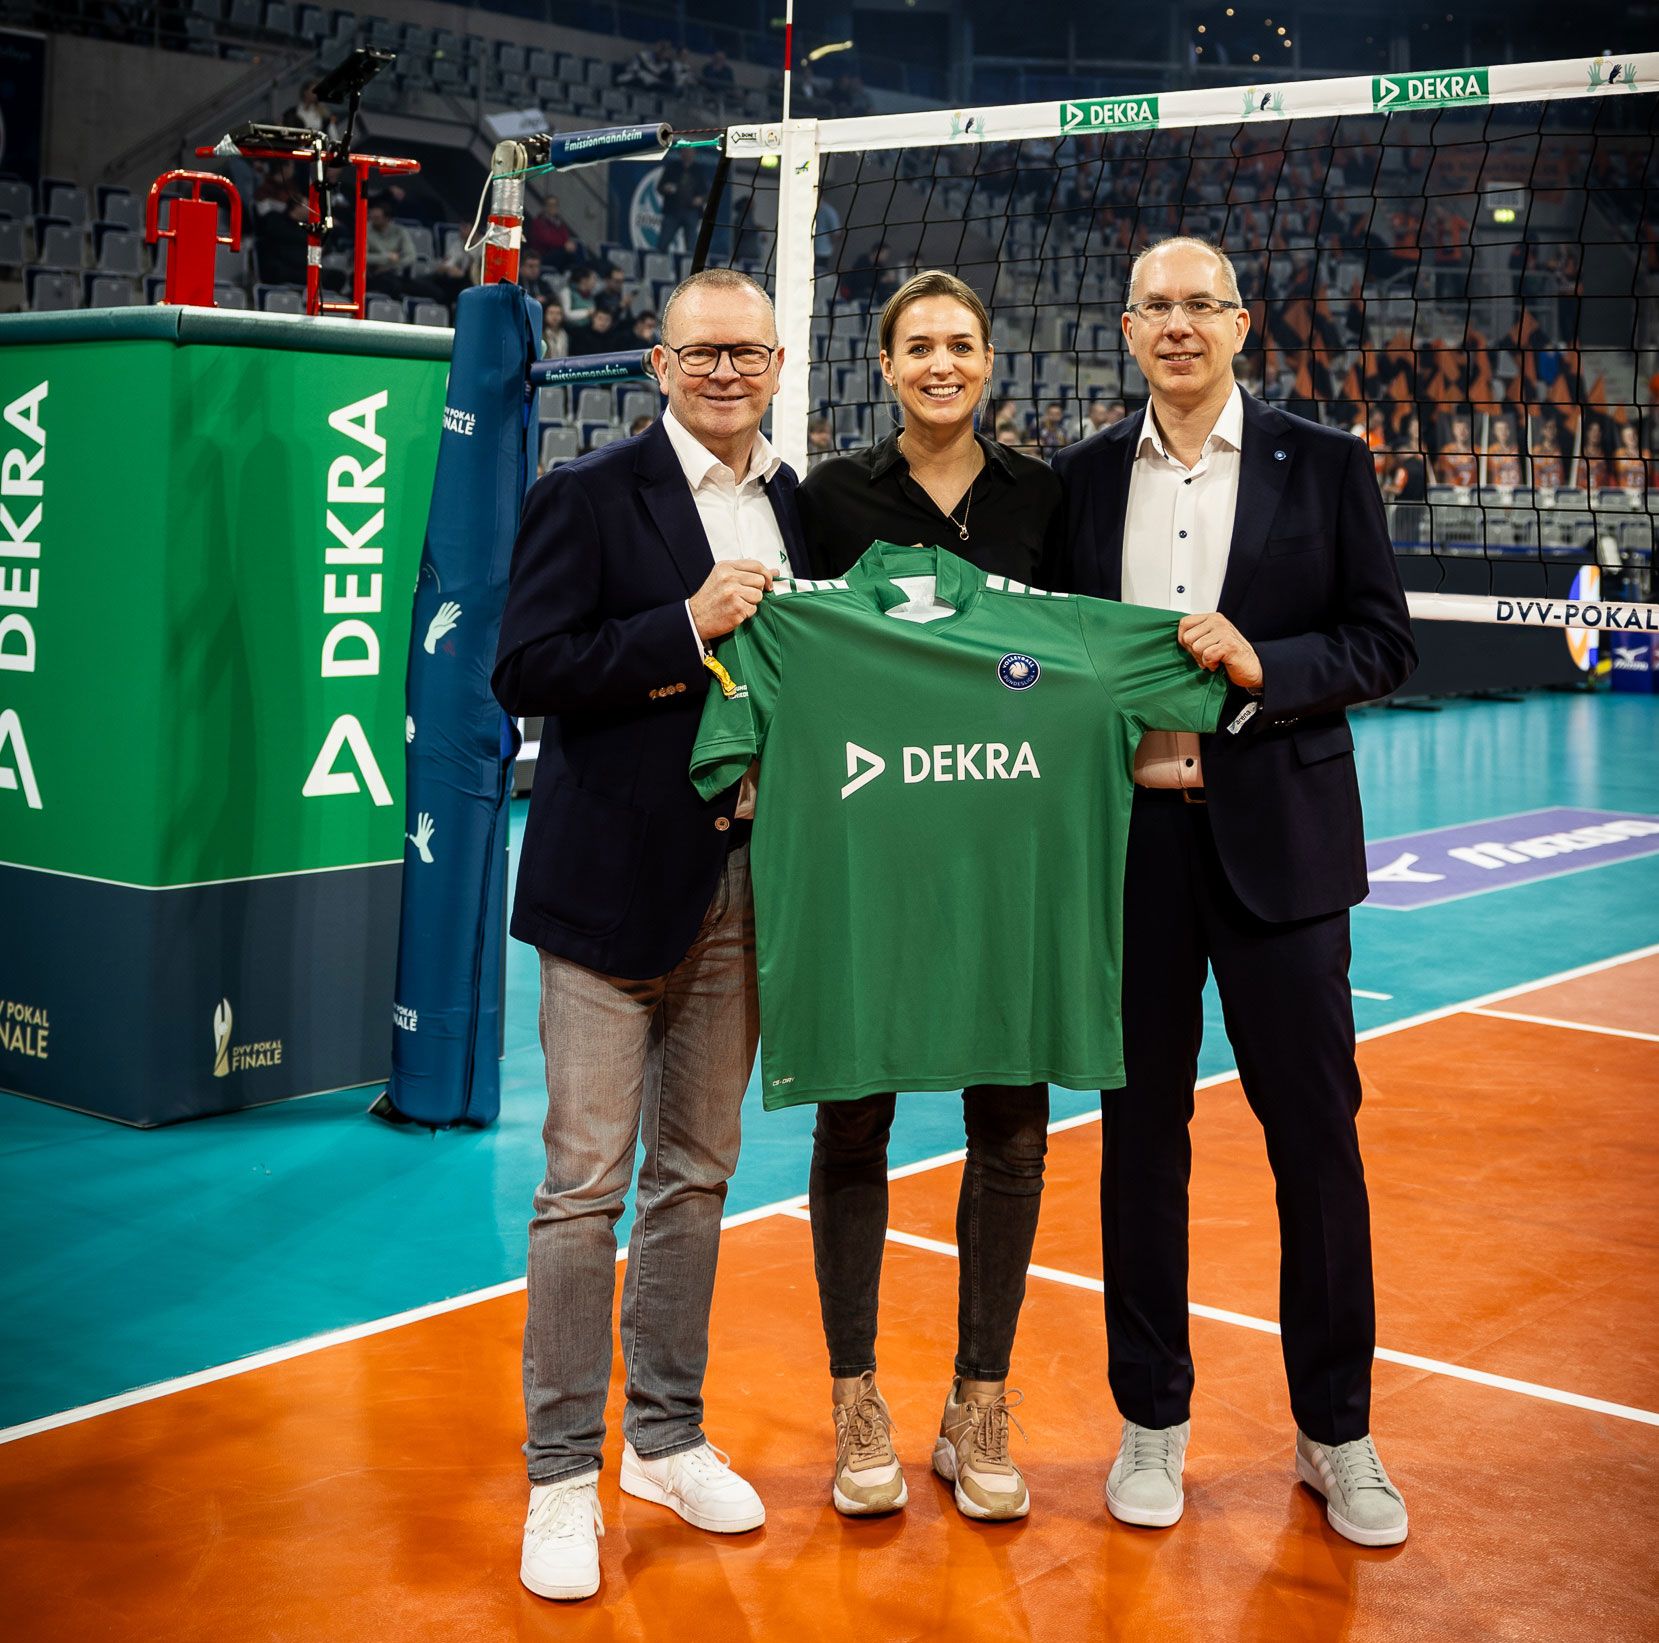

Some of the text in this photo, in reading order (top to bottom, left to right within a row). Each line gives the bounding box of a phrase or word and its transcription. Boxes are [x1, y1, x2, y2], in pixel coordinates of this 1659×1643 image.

[1408, 74, 1482, 101] DEKRA
[1090, 101, 1154, 125] DEKRA
[564, 128, 643, 152] #missionmannheim
[545, 364, 629, 381] #missionmannheim
[0, 379, 49, 673] DEKRA
[321, 389, 389, 678] DEKRA
[1496, 600, 1659, 630] DVV-POKAL
[1002, 655, 1035, 669] VOLLEYBALL
[902, 741, 1041, 784] DEKRA
[6, 1001, 50, 1028] POKAL
[253, 1039, 282, 1053] POKAL
[232, 1049, 282, 1072] FINALE
